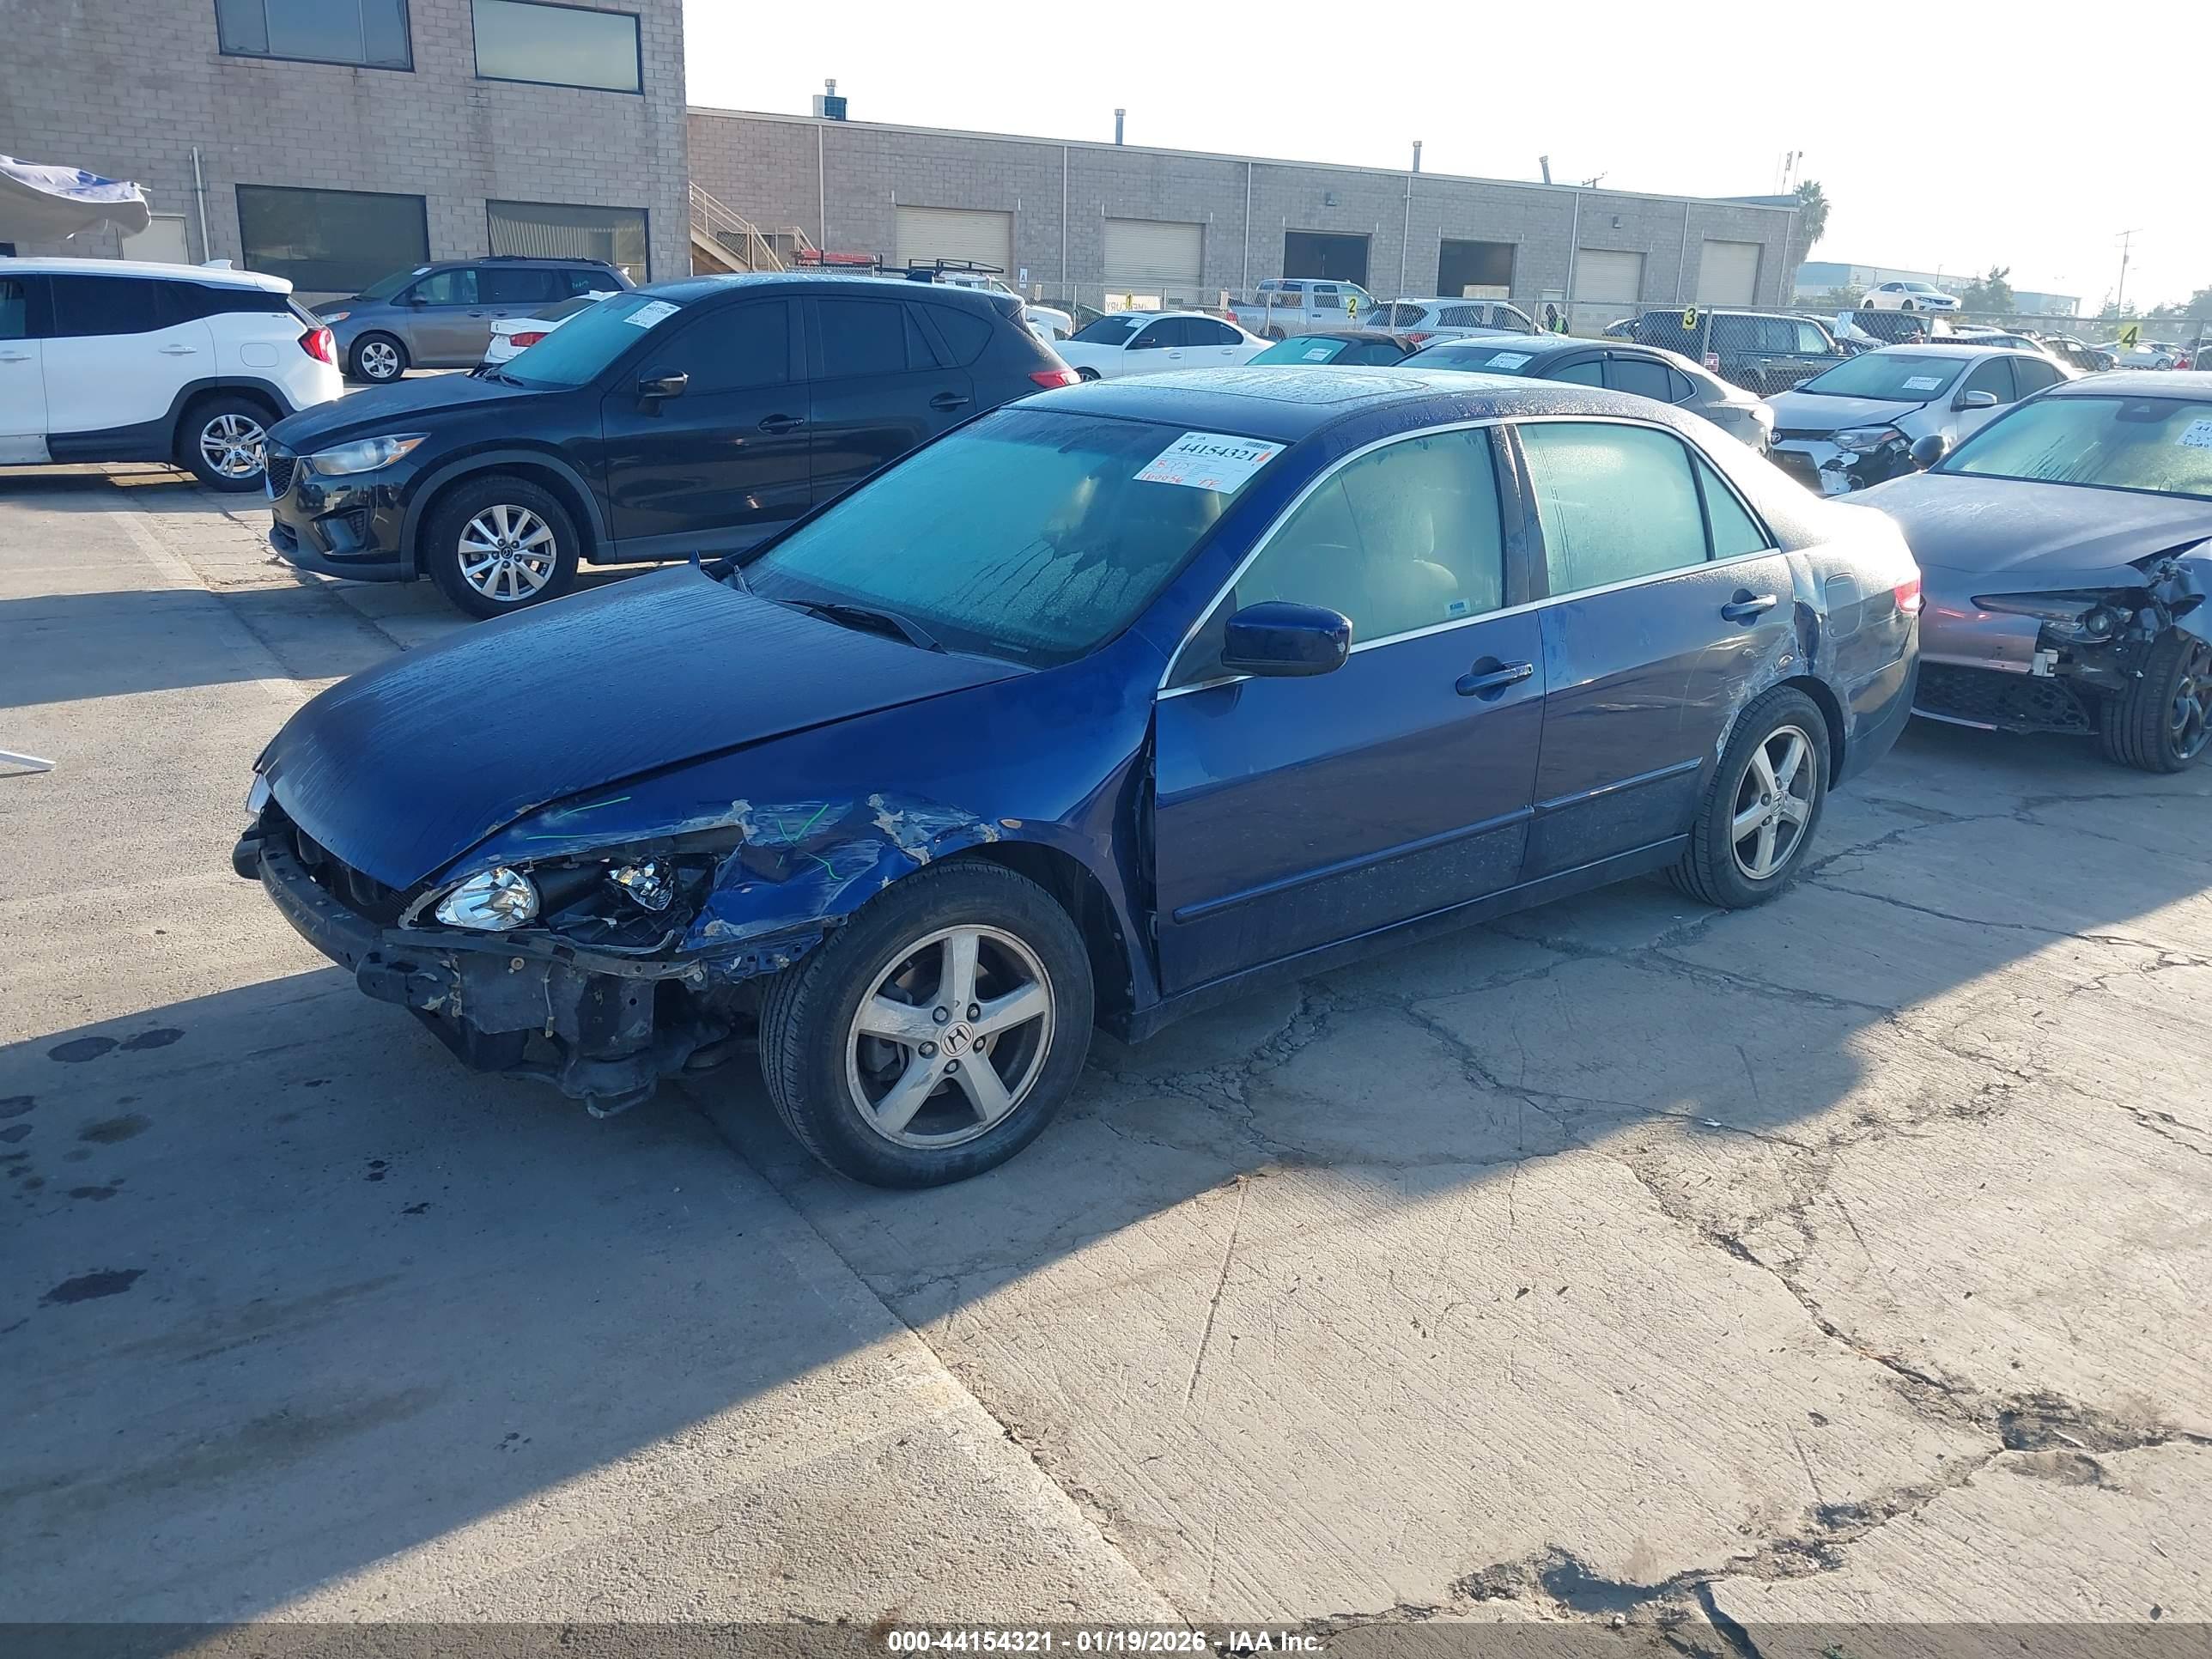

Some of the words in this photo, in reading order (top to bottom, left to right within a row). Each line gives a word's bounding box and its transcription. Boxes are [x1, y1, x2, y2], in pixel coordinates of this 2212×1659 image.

[1127, 294, 1132, 307] 1
[1348, 298, 1357, 313] 2
[1685, 307, 1696, 325] 3
[2122, 326, 2138, 349] 4
[1177, 443, 1260, 461] 44154321
